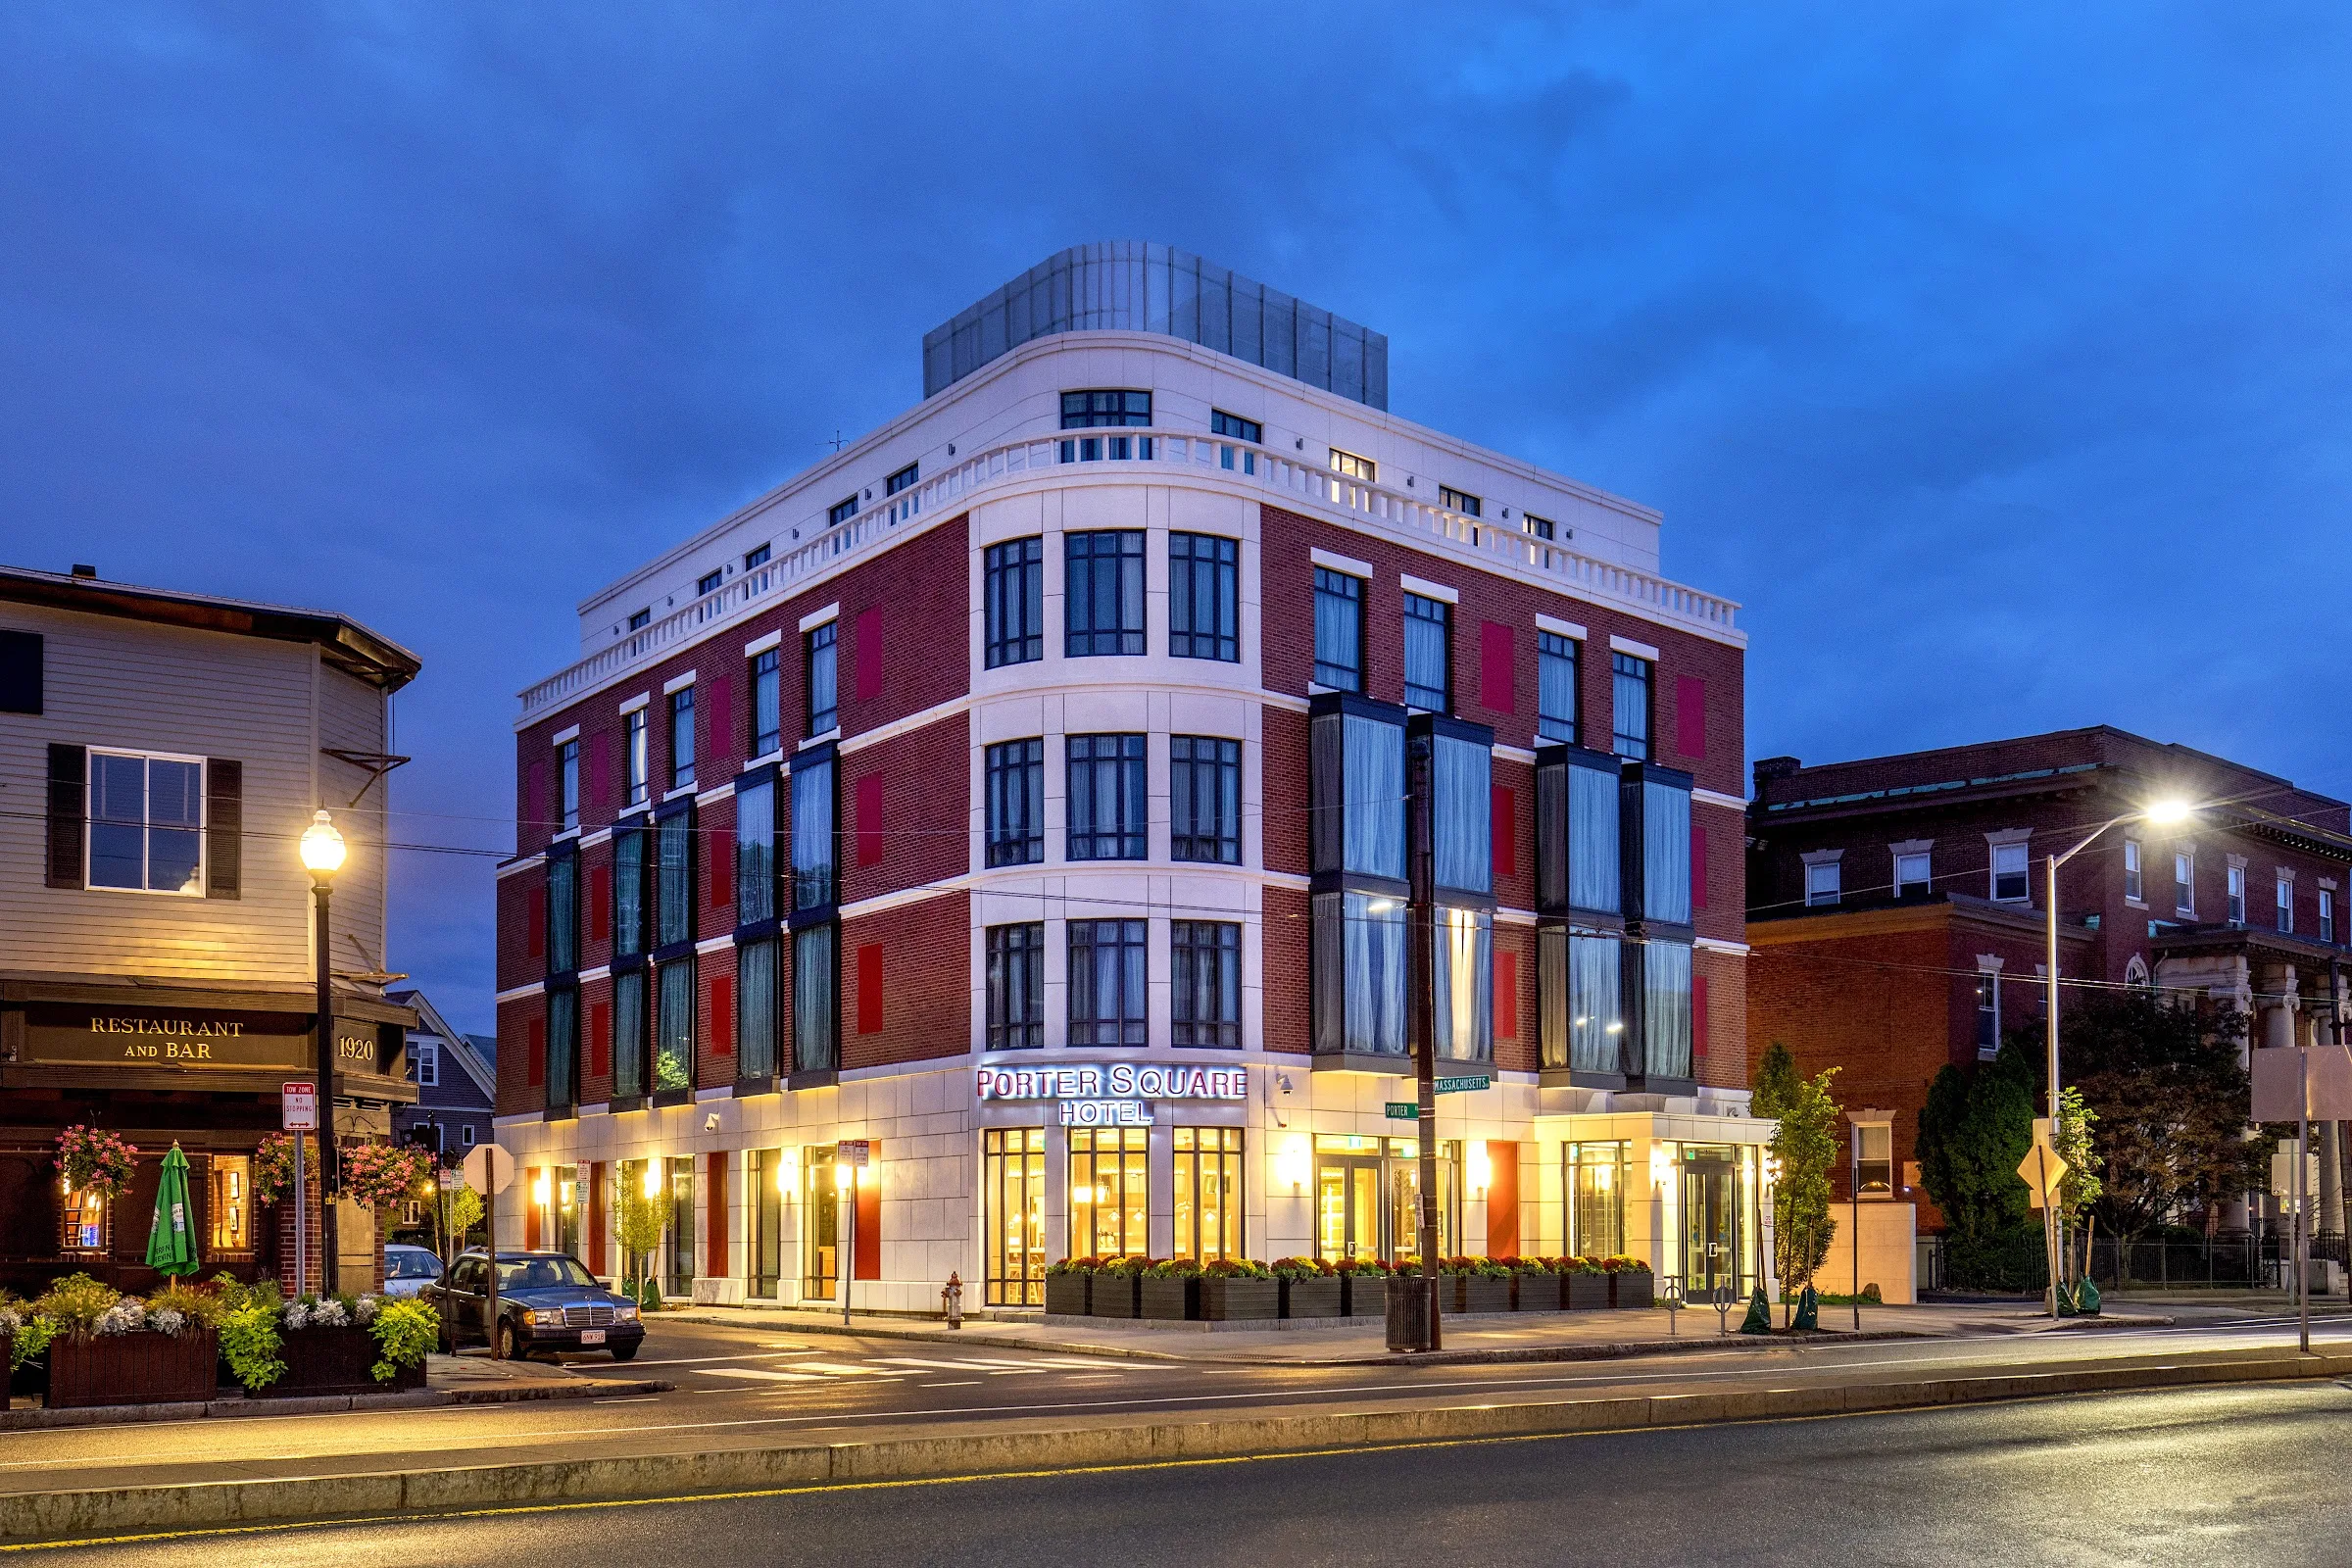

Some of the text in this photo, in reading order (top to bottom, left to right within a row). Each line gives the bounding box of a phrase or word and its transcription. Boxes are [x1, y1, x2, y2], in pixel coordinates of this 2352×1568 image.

[90, 1017, 244, 1038] RESTAURANT
[123, 1042, 212, 1058] AND BAR
[339, 1037, 373, 1060] 1920
[977, 1066, 1248, 1097] PORTER SQUARE
[1435, 1077, 1486, 1092] MASSACHUSETTS
[1059, 1102, 1152, 1123] HOTEL
[1386, 1104, 1408, 1116] PORTER
